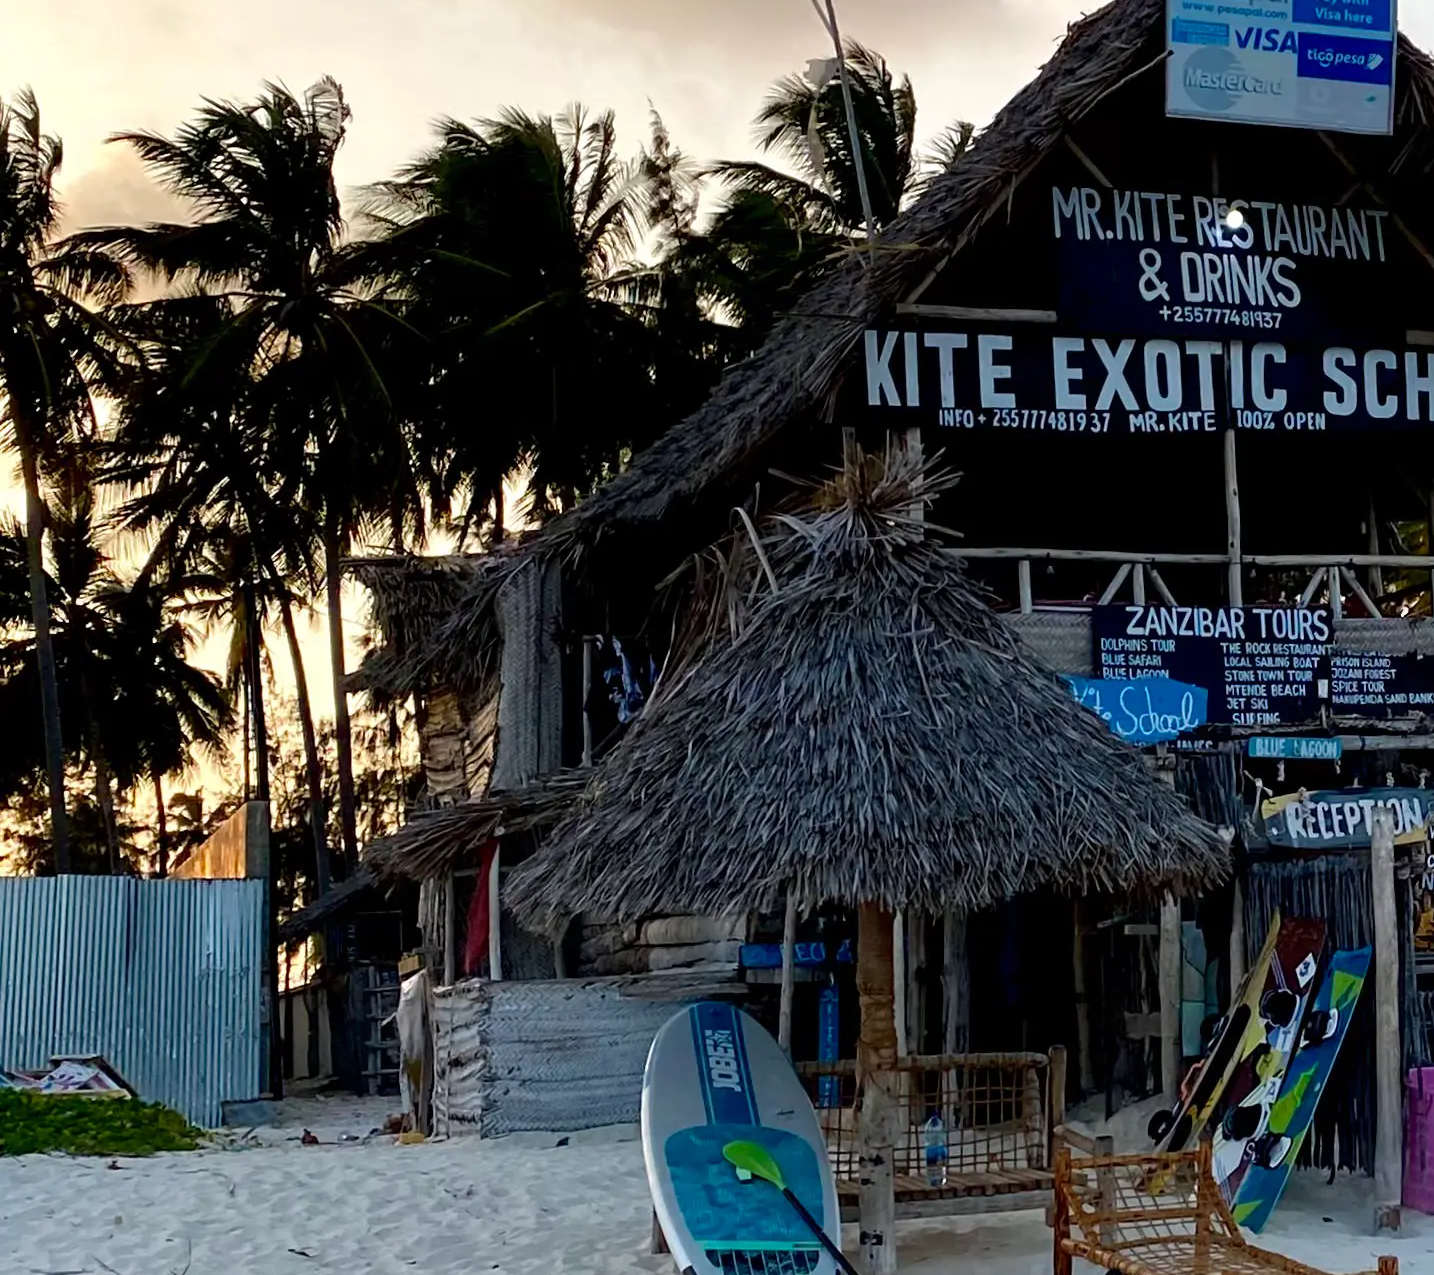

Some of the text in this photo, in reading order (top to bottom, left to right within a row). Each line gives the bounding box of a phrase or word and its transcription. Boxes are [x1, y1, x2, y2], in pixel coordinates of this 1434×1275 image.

[1315, 7, 1373, 24] Visa here
[1235, 27, 1297, 54] VISA
[1053, 187, 1388, 262] MR.KITE RESTAURANT
[1139, 248, 1301, 308] & DRINKS
[1159, 305, 1282, 329] +255777481937
[864, 330, 1016, 408] KITE
[1053, 337, 1287, 413] EXOTIC
[1236, 410, 1275, 430] 100%
[1284, 412, 1325, 430] OPEN
[1125, 606, 1330, 642] ZANZIBAR TOURS
[1100, 637, 1176, 653] DOLPHINS TOUR
[1220, 642, 1241, 654] THE
[1245, 642, 1270, 655] ROCK
[1273, 643, 1335, 656] RESTAURANT
[1101, 652, 1162, 666] BLUE SAFARI
[1224, 656, 1320, 669] LOCAL SAILING BOAT
[1224, 670, 1313, 682] STONE TOWN TOUR
[1271, 685, 1306, 697] BEACH
[1332, 681, 1386, 693] SPICE TOUR
[1227, 698, 1268, 710] JET SKI
[1256, 737, 1286, 757] BLUE
[1285, 798, 1424, 839] RECEPTON
